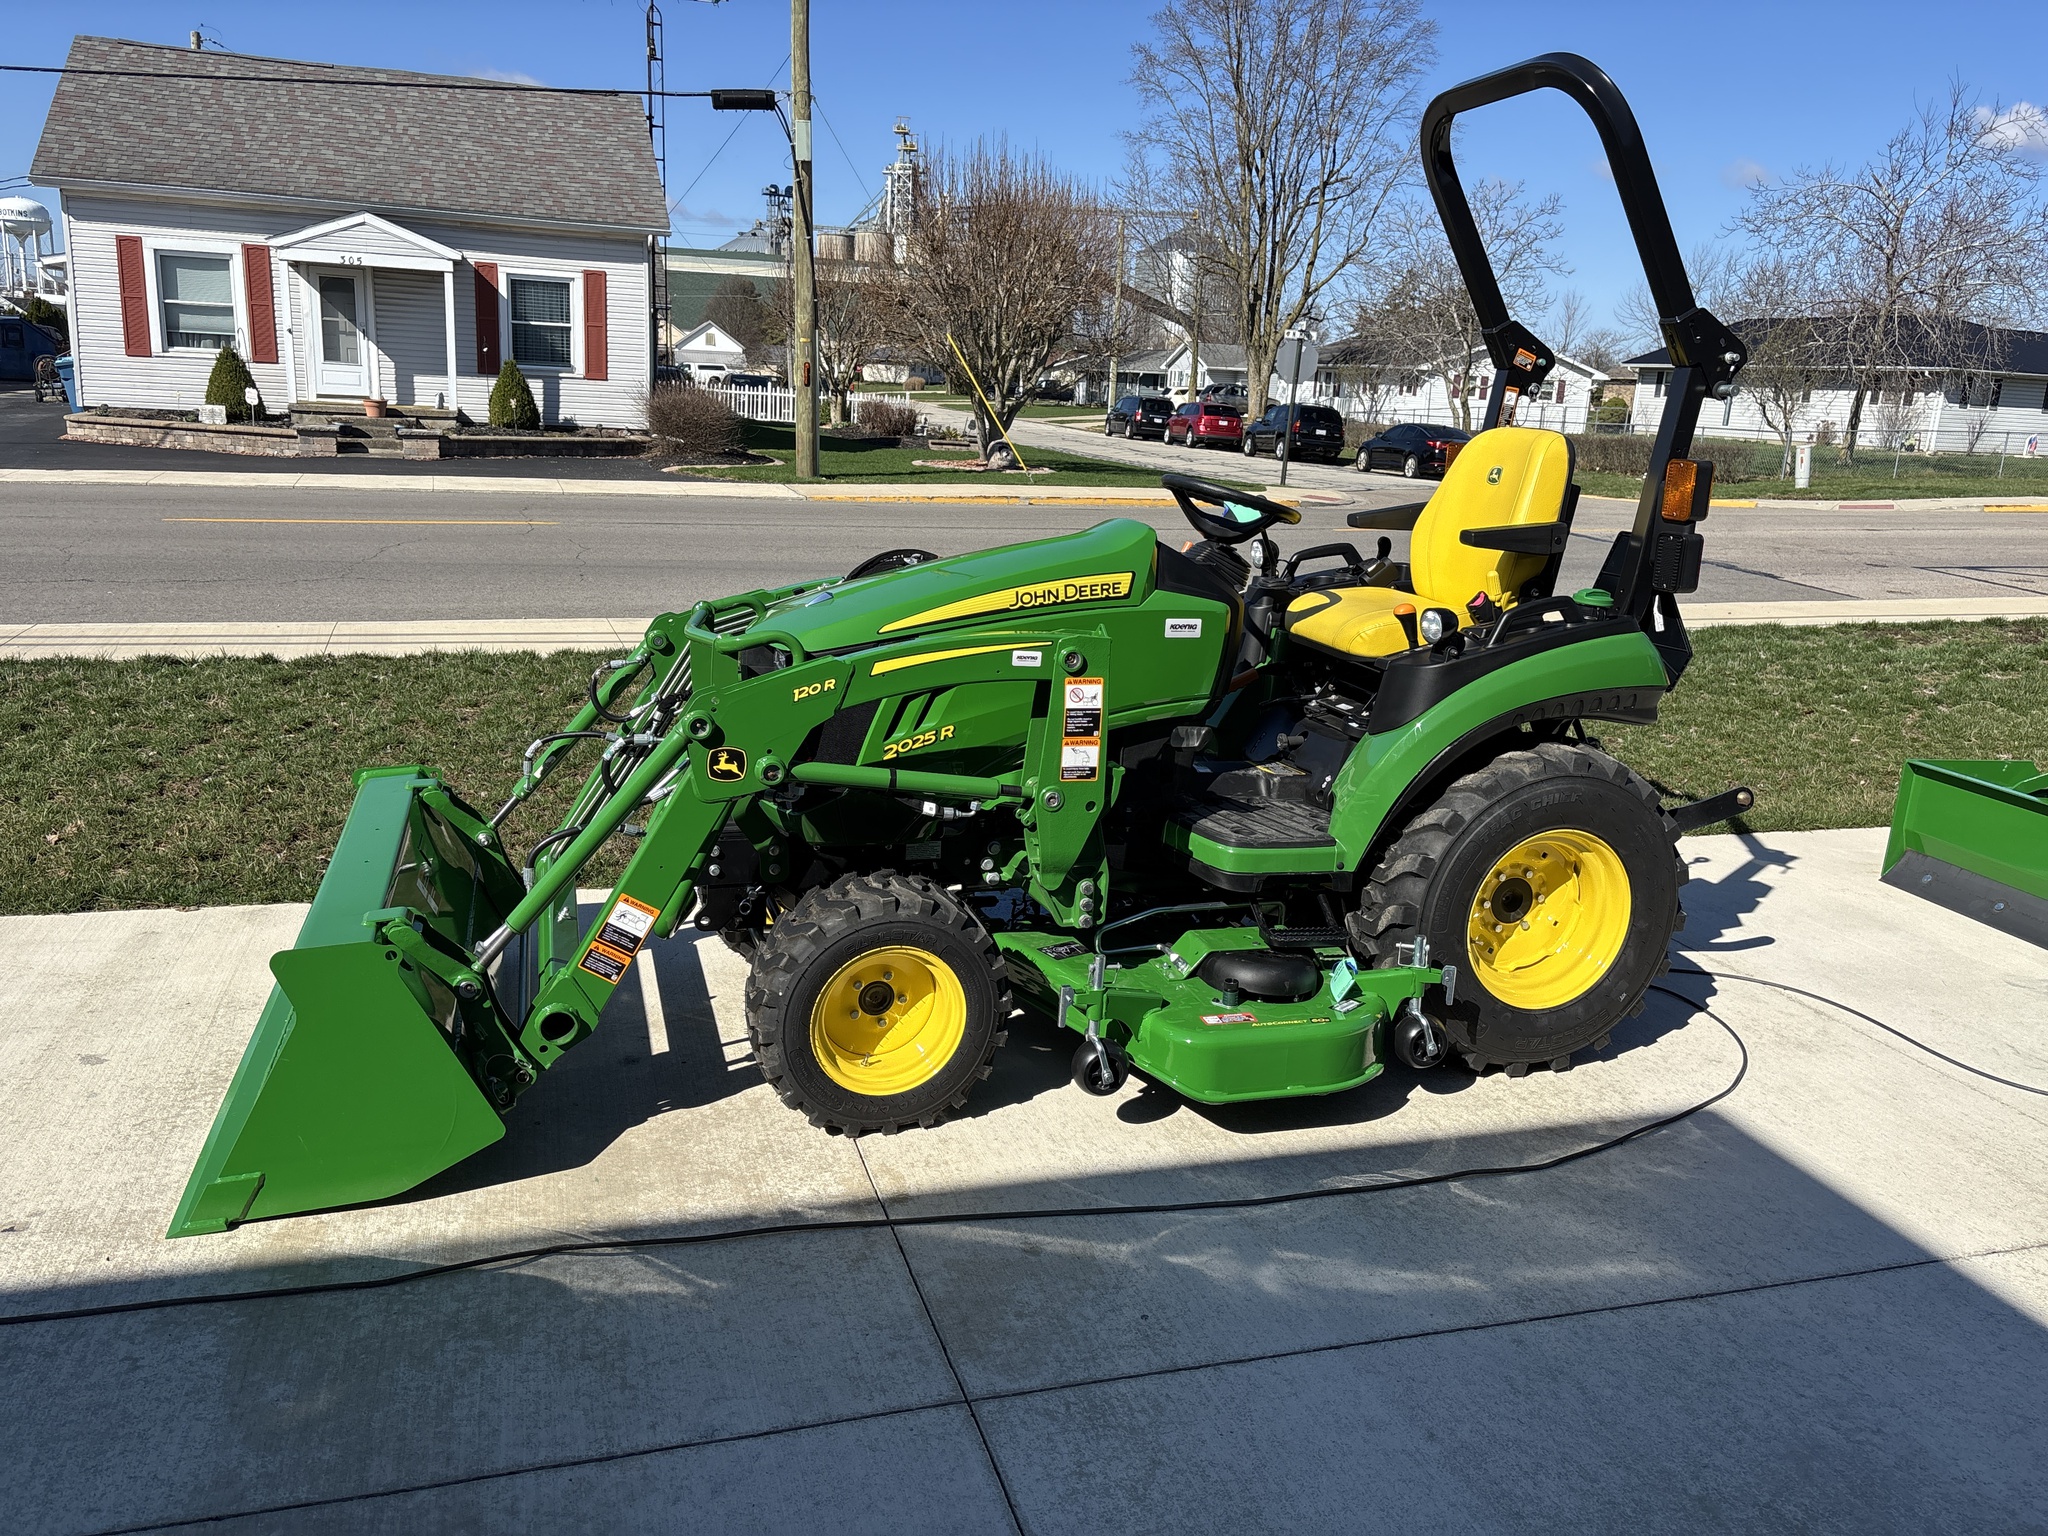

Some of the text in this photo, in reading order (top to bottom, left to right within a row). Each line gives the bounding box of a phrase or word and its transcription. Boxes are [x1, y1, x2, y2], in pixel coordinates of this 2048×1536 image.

[340, 255, 362, 265] 305
[1009, 581, 1122, 608] JOHN DEERE
[793, 678, 836, 702] 120 R
[883, 725, 955, 761] 2025 R
[1530, 792, 1583, 811] CHIEF
[630, 899, 654, 915] WARNING
[601, 948, 626, 962] WARNING
